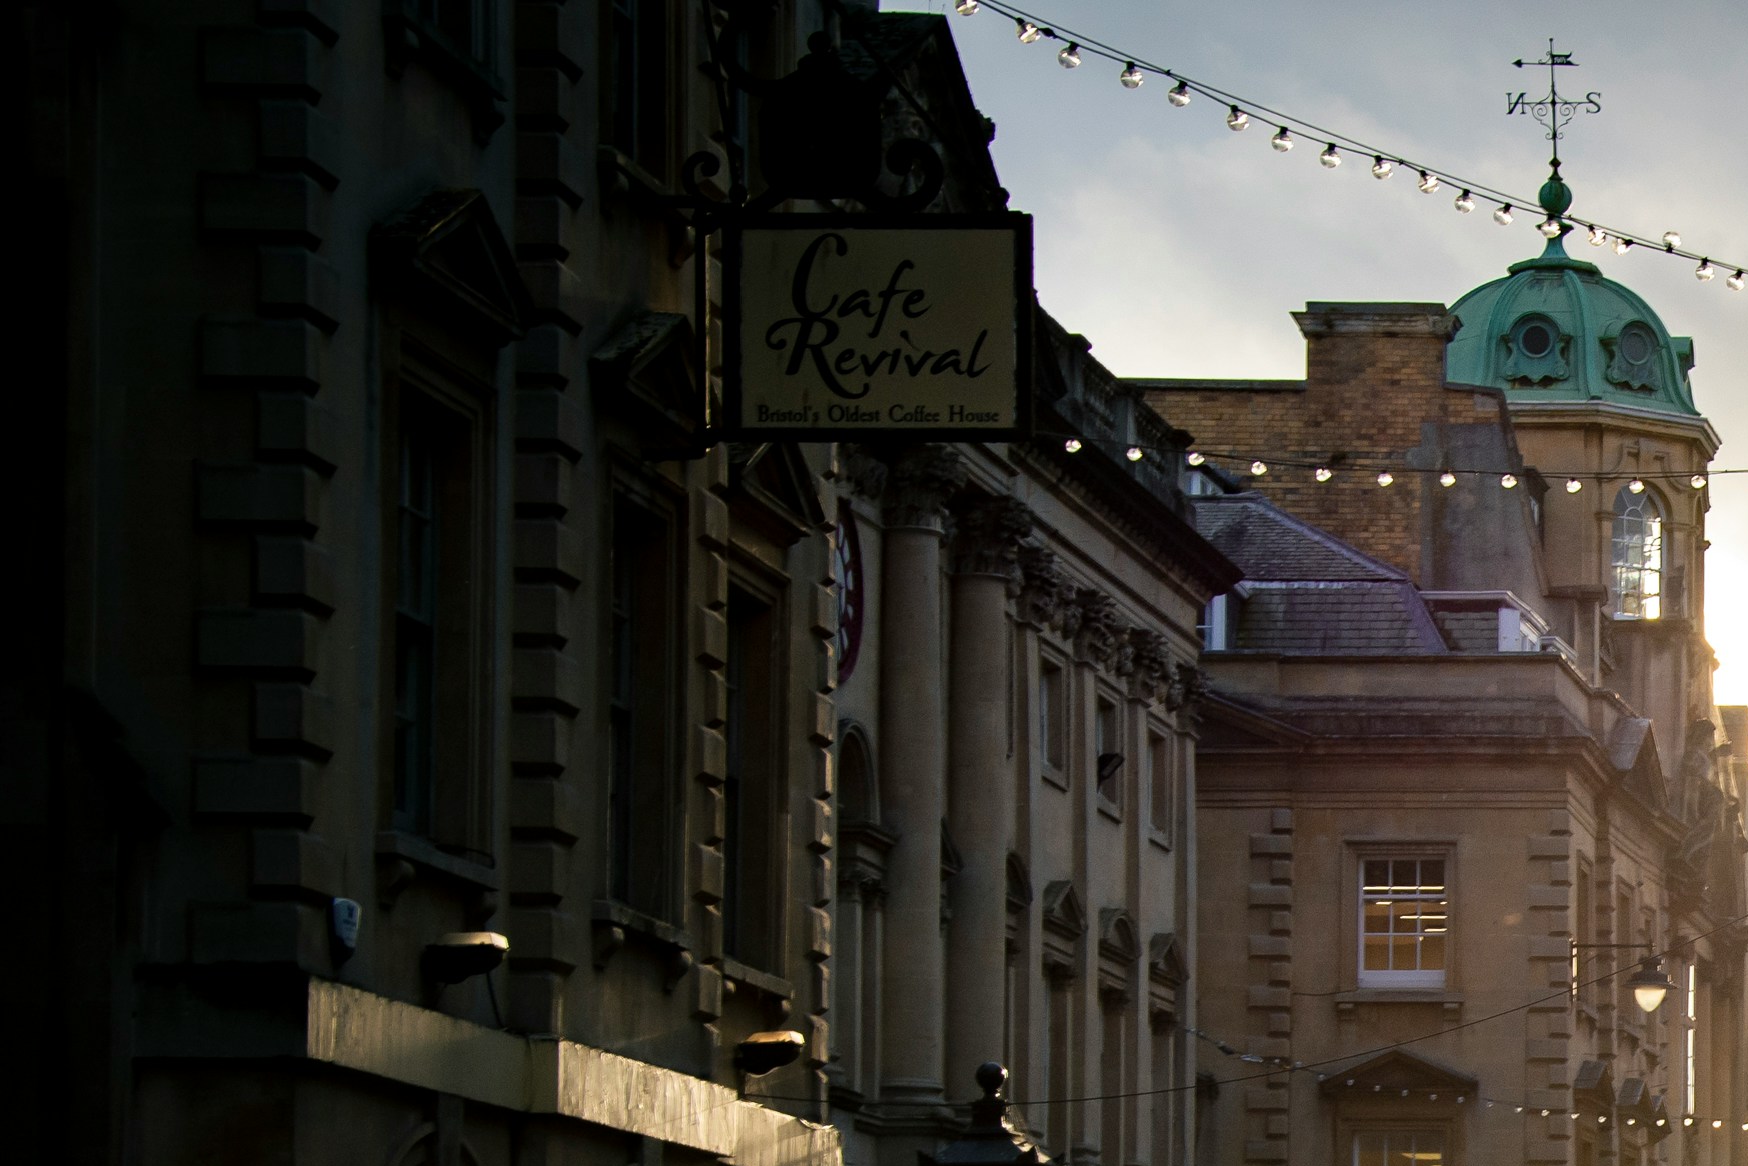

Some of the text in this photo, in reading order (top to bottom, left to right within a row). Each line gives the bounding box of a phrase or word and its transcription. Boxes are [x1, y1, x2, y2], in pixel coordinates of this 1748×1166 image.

[1586, 92, 1602, 114] S
[791, 232, 933, 338] Cafe
[765, 317, 993, 399] Revival
[757, 404, 999, 423] Bristol's Oldest Coffee House
